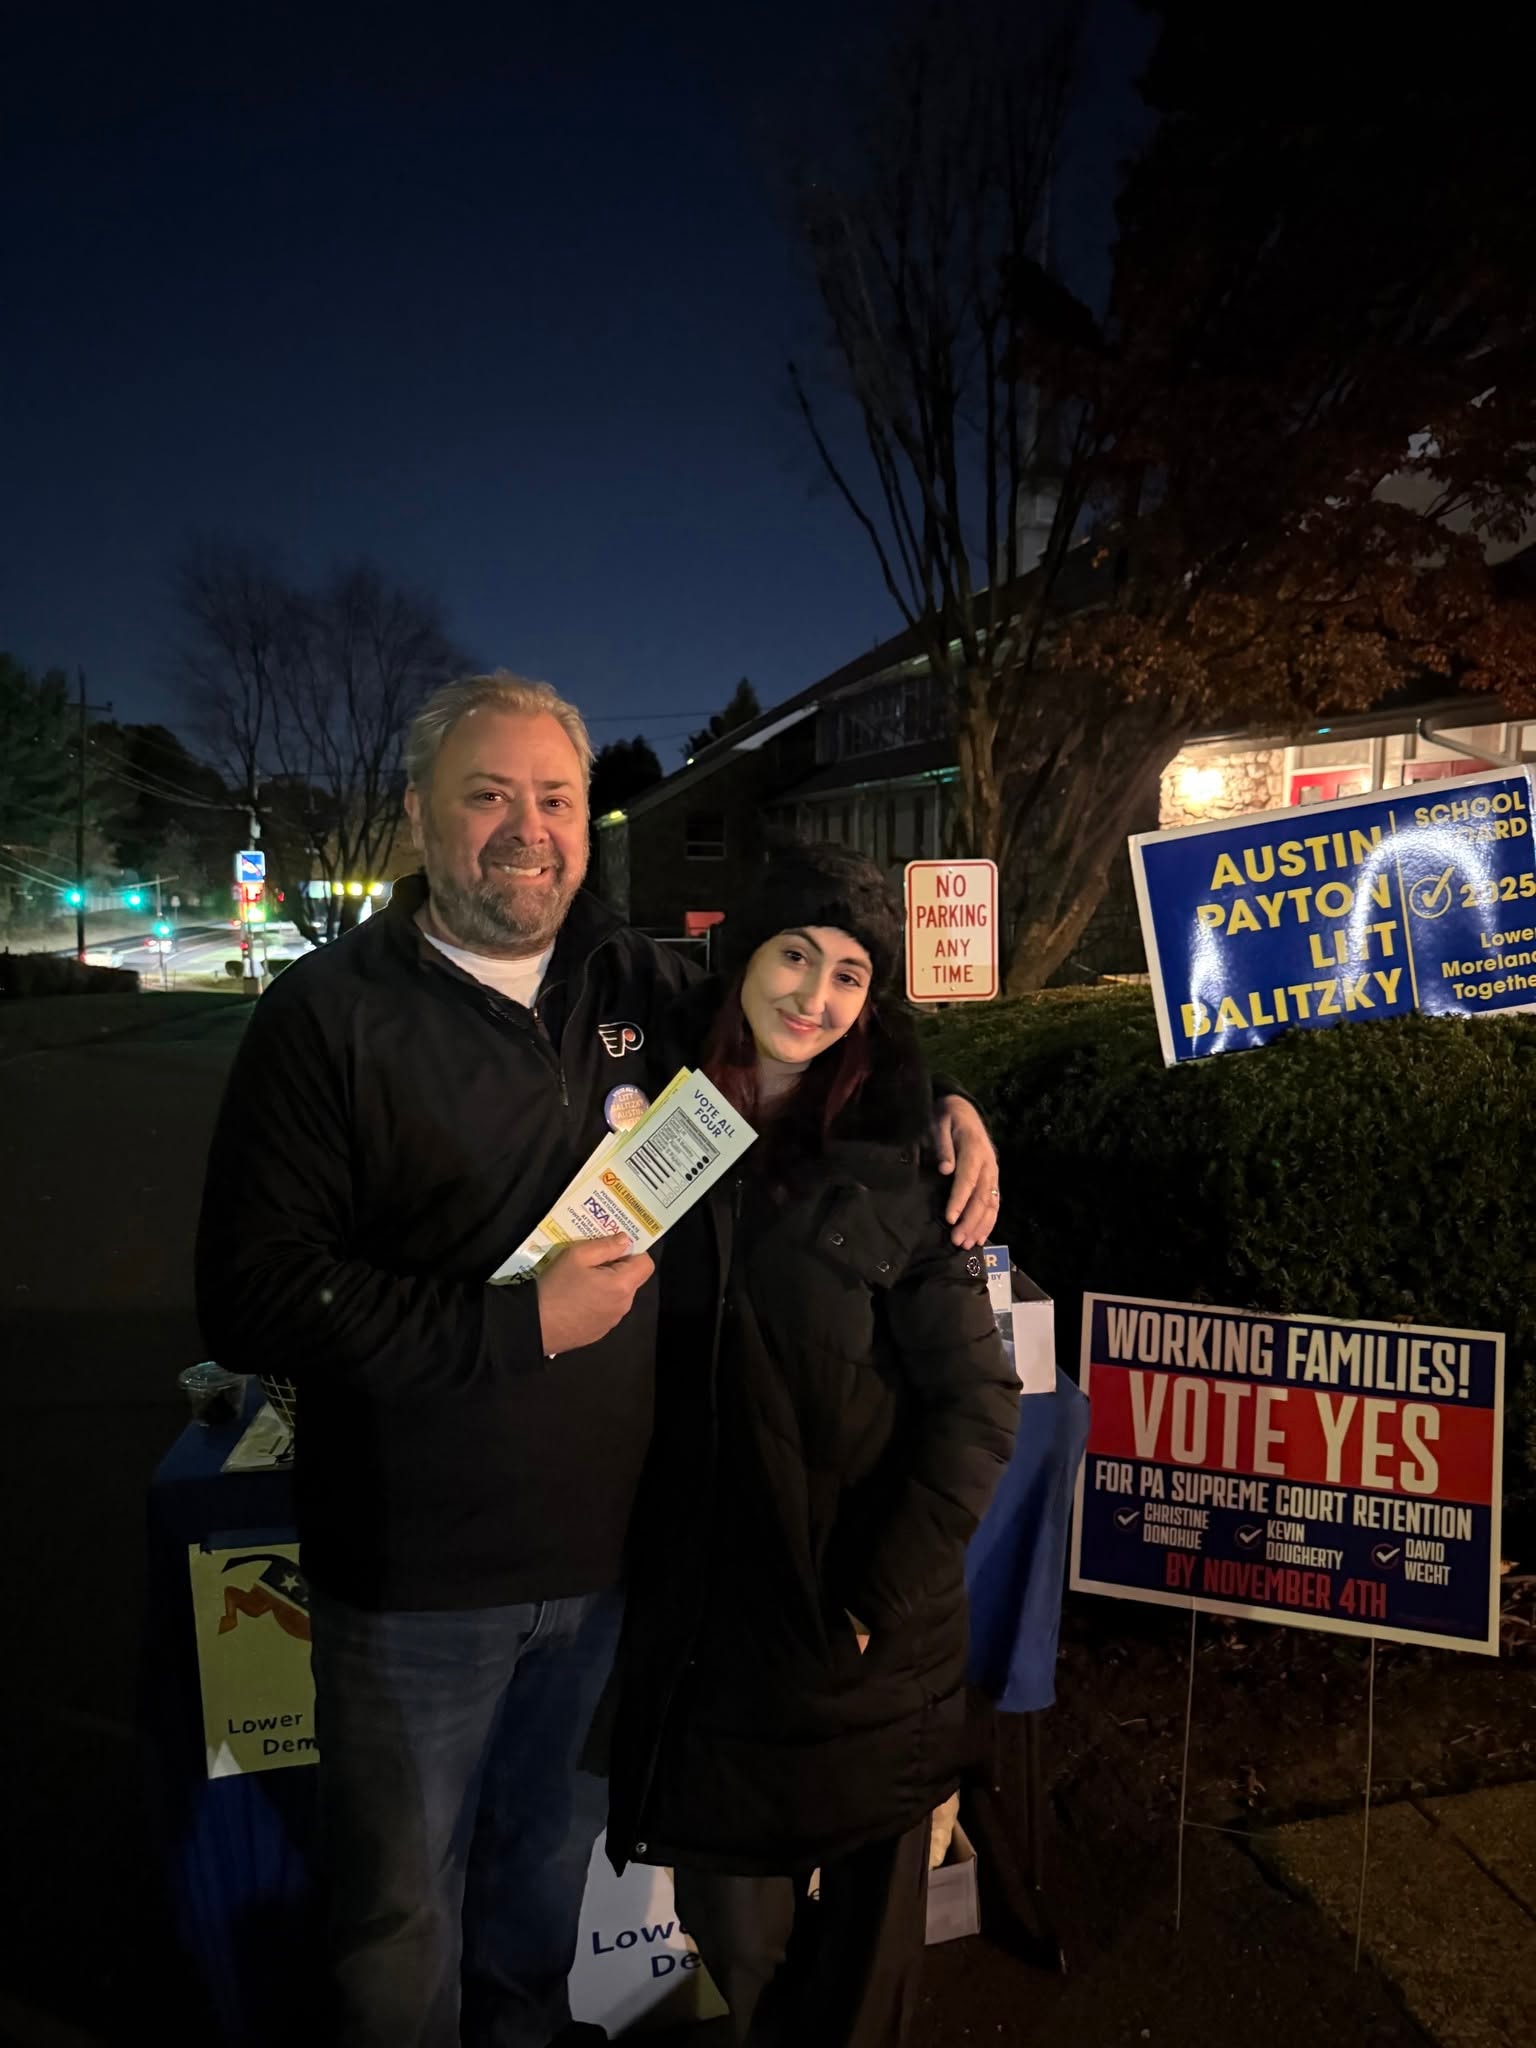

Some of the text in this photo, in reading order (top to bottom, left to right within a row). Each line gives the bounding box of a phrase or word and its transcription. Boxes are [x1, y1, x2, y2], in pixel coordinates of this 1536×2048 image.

[1414, 791, 1526, 828] SCHOOL
[1452, 817, 1528, 843] OARD
[1210, 826, 1382, 890] AUSTIN
[936, 874, 966, 898] NO
[1460, 873, 1536, 908] 2025
[916, 904, 988, 929] PARKING
[1196, 874, 1392, 935] PAYTON
[935, 938, 970, 958] ANY
[1309, 921, 1397, 969] LITT
[1480, 927, 1536, 948] Lowe
[932, 964, 974, 983] TIME
[1452, 974, 1536, 1000] Togethe
[1180, 968, 1402, 1038] BALITZKY
[693, 1089, 720, 1119] VOTE
[718, 1119, 735, 1138] ALL
[694, 1108, 722, 1138] FOUR
[584, 1196, 621, 1234] PSEAPA
[1107, 1307, 1470, 1399] WORKING FAMILIES!
[1129, 1370, 1440, 1494] VOTE YES
[1095, 1460, 1472, 1541] FOR PA SUPREME COURT RETENTION
[1144, 1502, 1210, 1529] CHRISTINE
[1143, 1523, 1202, 1550] DONOHUE
[1267, 1520, 1305, 1543] KEVIN
[1266, 1541, 1344, 1570] DOUGHERTY
[1405, 1538, 1445, 1563] DAVID
[1166, 1552, 1387, 1619] BY NOVEMBER 4TH
[1405, 1560, 1451, 1586] WECHT
[227, 1713, 303, 1734] Lower
[263, 1737, 319, 1756] Dem
[592, 1921, 688, 1955] Low
[651, 1953, 701, 1978] De
